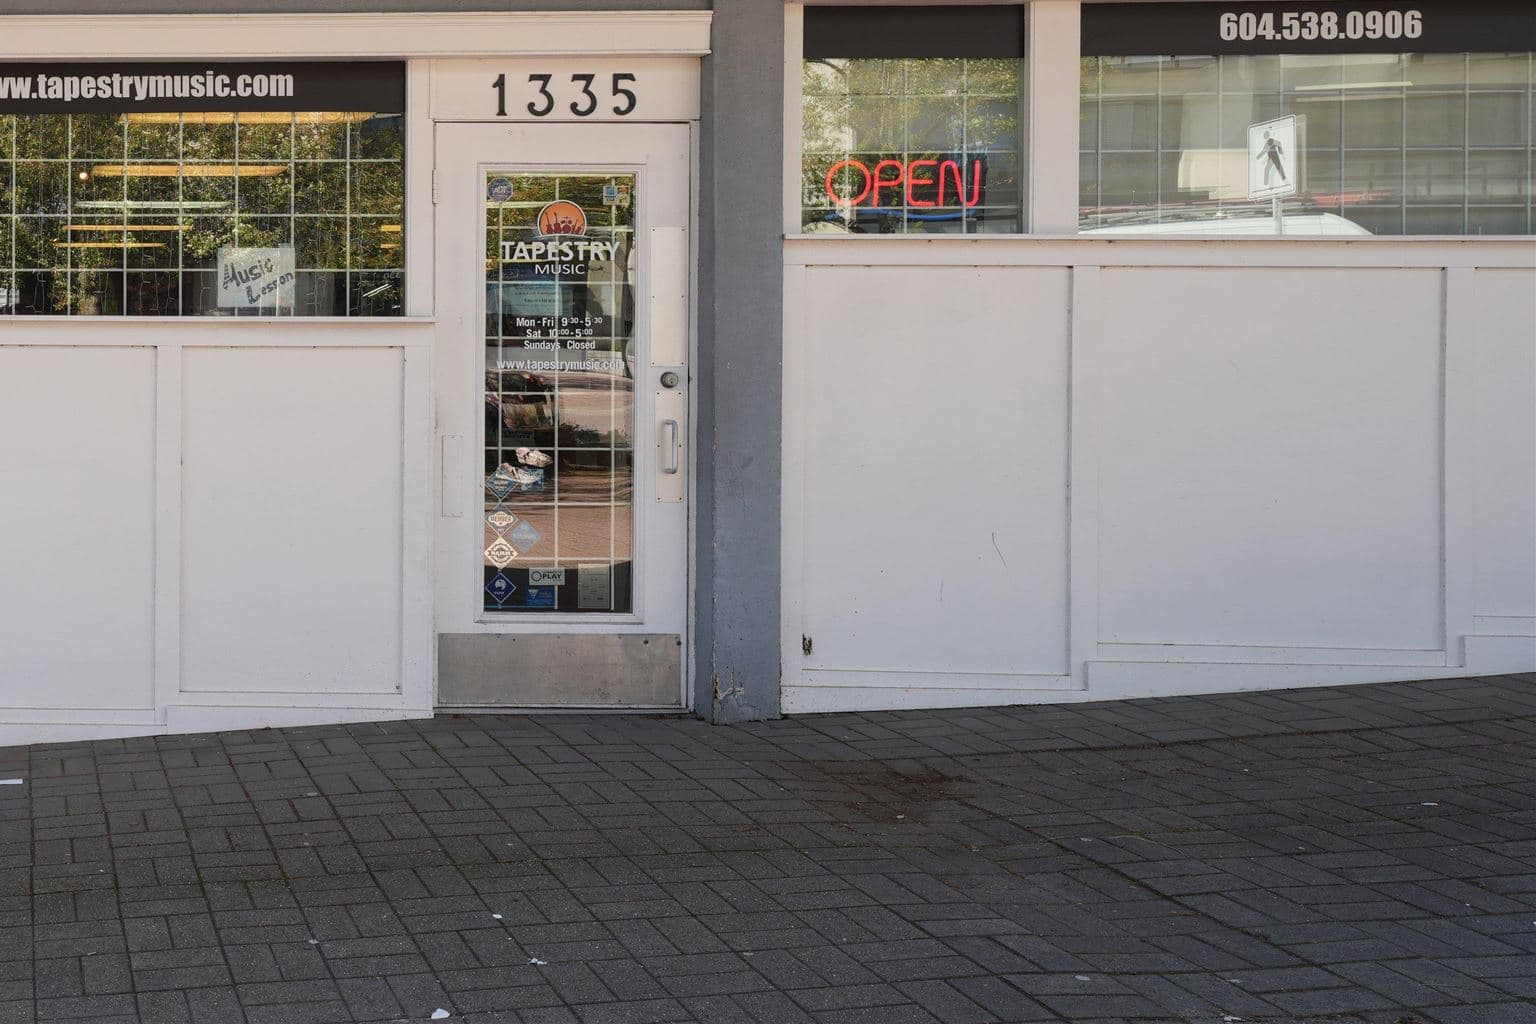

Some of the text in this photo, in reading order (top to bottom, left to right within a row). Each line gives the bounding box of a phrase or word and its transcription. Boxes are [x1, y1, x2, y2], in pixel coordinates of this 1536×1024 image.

[1219, 9, 1423, 41] 604.538.0906
[491, 72, 637, 117] 1335
[824, 159, 982, 208] OPEN
[501, 240, 621, 262] TAPESTRY
[534, 263, 586, 275] MUSIC
[525, 328, 542, 338] Sat
[523, 339, 596, 351] Sundays Closed
[496, 358, 625, 372] www.tapestrymusic.com
